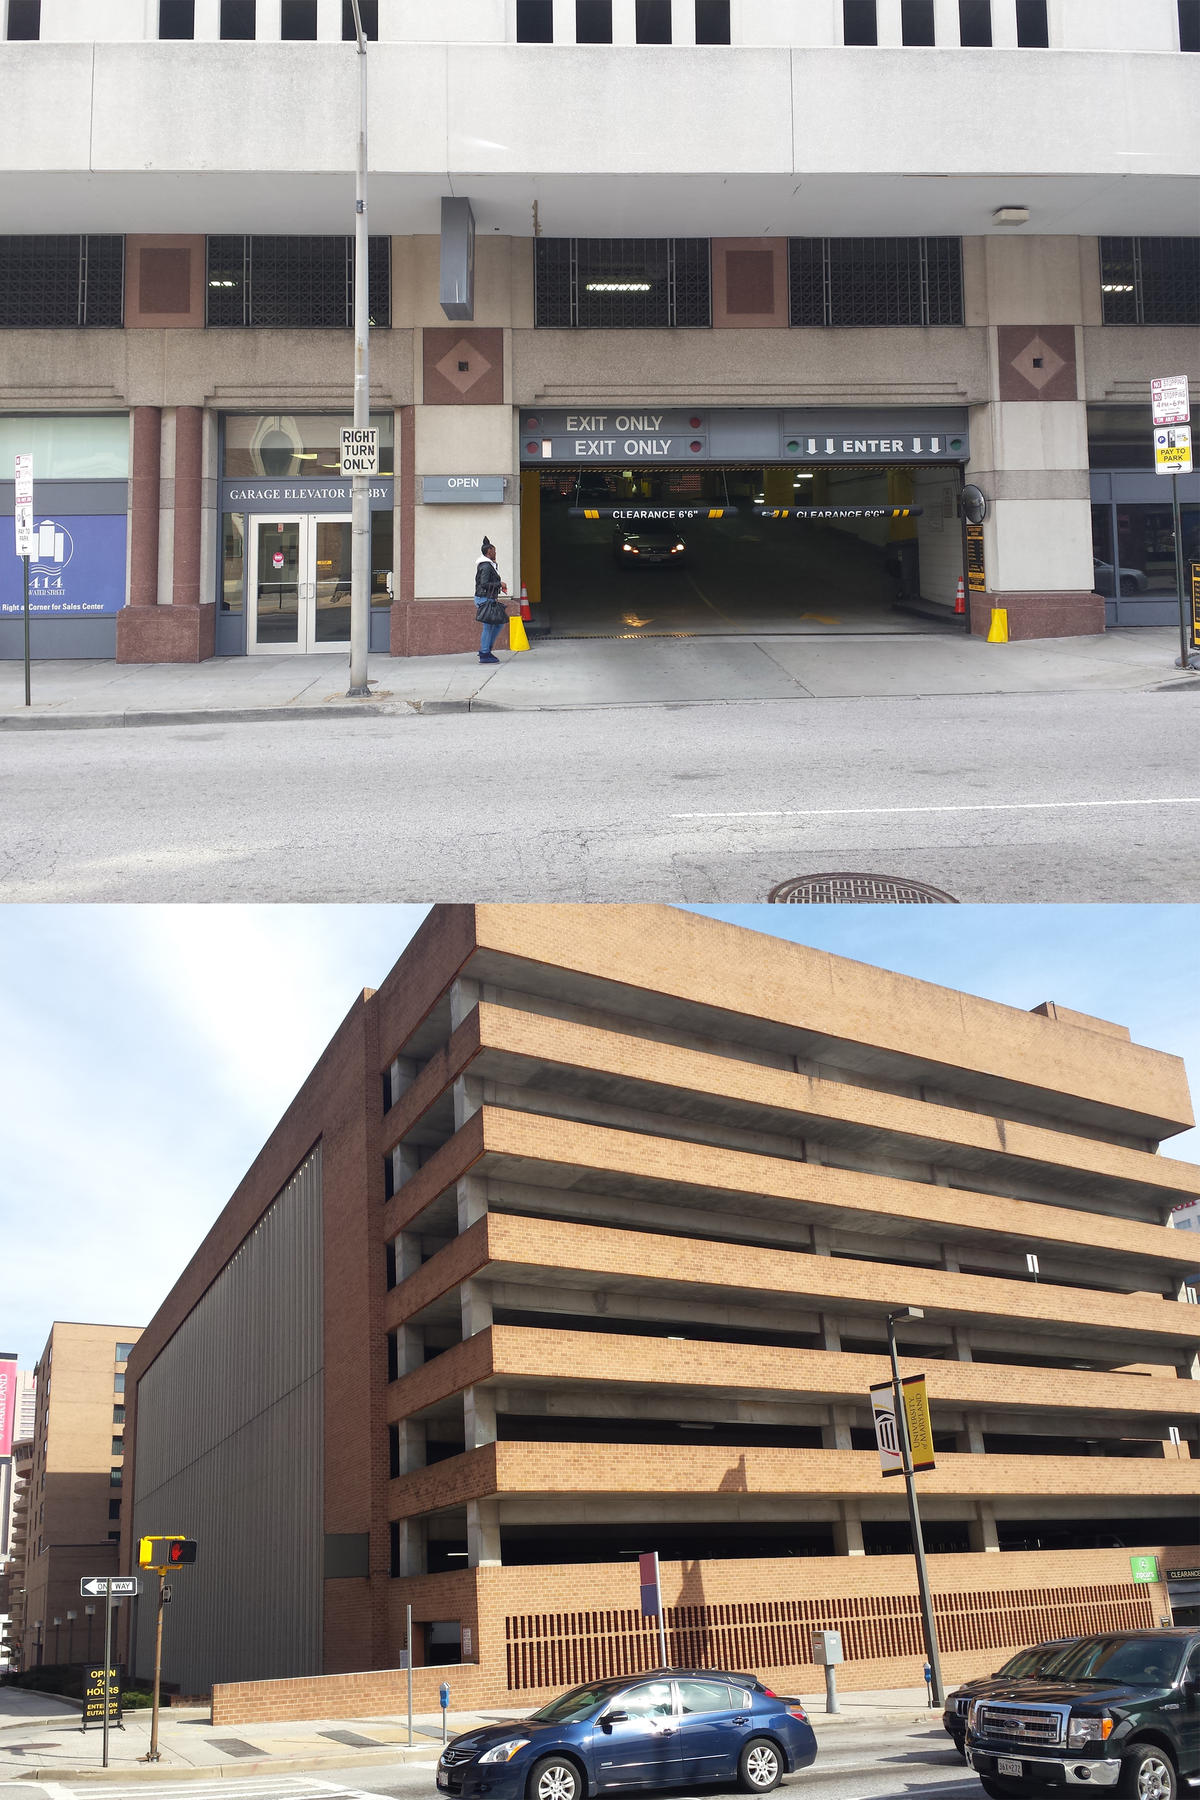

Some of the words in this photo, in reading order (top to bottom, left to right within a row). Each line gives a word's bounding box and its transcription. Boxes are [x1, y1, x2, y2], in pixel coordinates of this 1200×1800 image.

[566, 416, 607, 431] EXIT
[615, 415, 663, 431] ONLY
[342, 430, 376, 443] RIGHT
[344, 444, 375, 456] TURN
[575, 440, 616, 455] EXIT
[624, 439, 672, 455] ONLY
[842, 439, 904, 453] ENTER
[343, 458, 376, 470] ONLY
[1163, 454, 1183, 462] PARK
[447, 478, 480, 488] OPEN
[230, 489, 280, 500] GARAGE
[284, 488, 345, 499] ELEVATOR
[612, 510, 676, 519] CLEARANCE
[678, 510, 699, 519] 6'6"
[796, 510, 862, 519] CLEARANCE
[28, 576, 63, 588] 414
[2, 604, 20, 612] Right
[28, 603, 50, 611] Corner
[82, 602, 104, 610] Center
[909, 1397, 920, 1449] UNIVERSITY
[916, 1392, 928, 1444] MARYLAND
[115, 1582, 131, 1590] WAY
